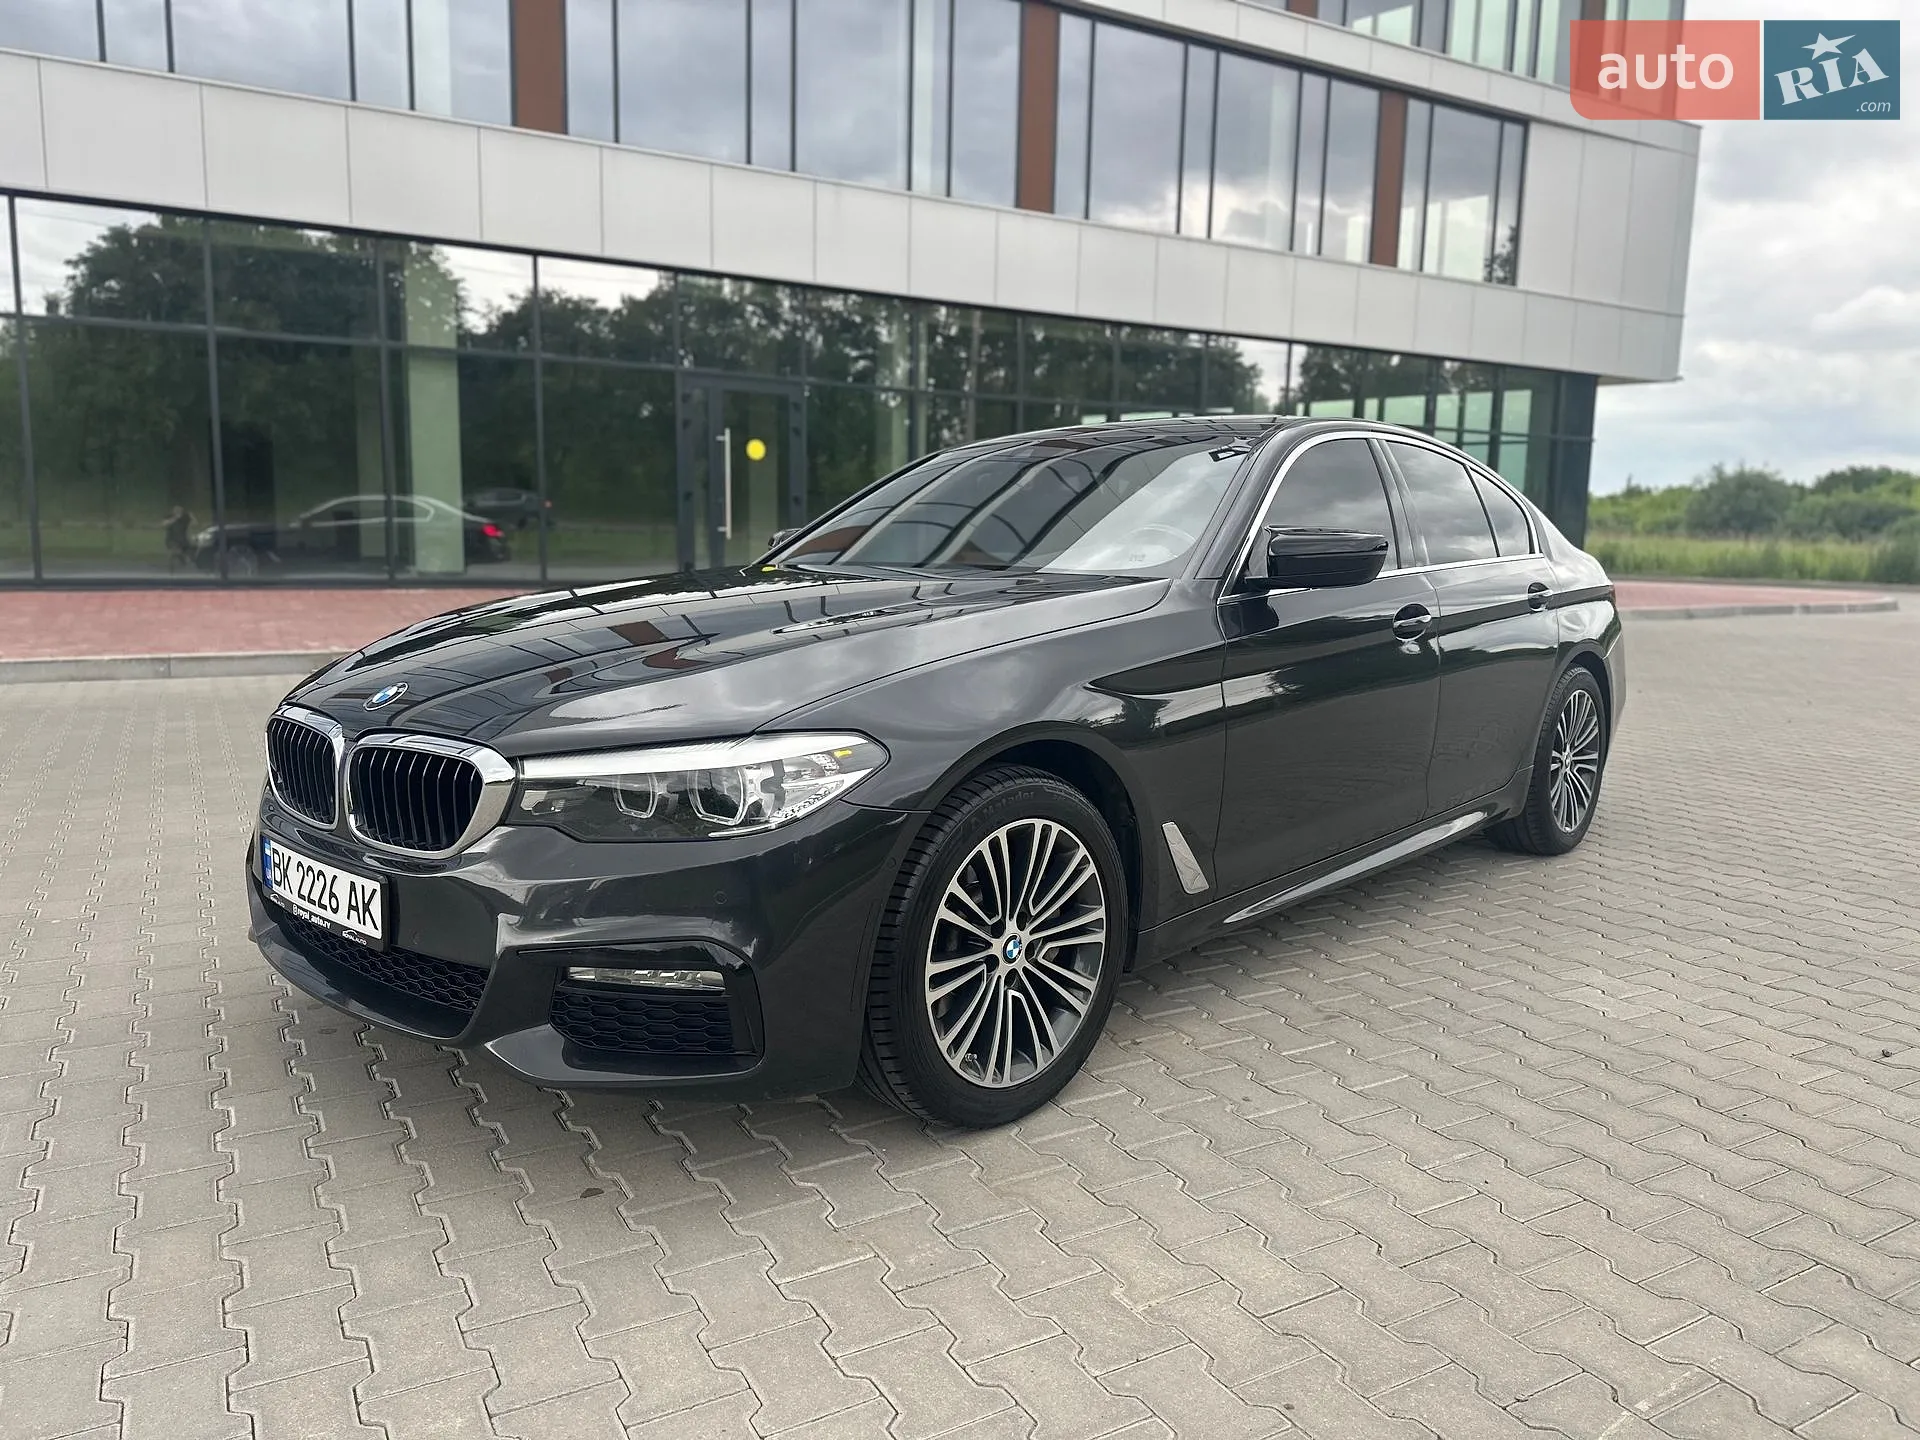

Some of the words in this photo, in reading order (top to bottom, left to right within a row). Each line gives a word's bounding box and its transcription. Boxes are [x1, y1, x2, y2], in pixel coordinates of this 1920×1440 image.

[272, 847, 293, 895] BK
[296, 860, 339, 914] 2226
[346, 881, 379, 931] AK
